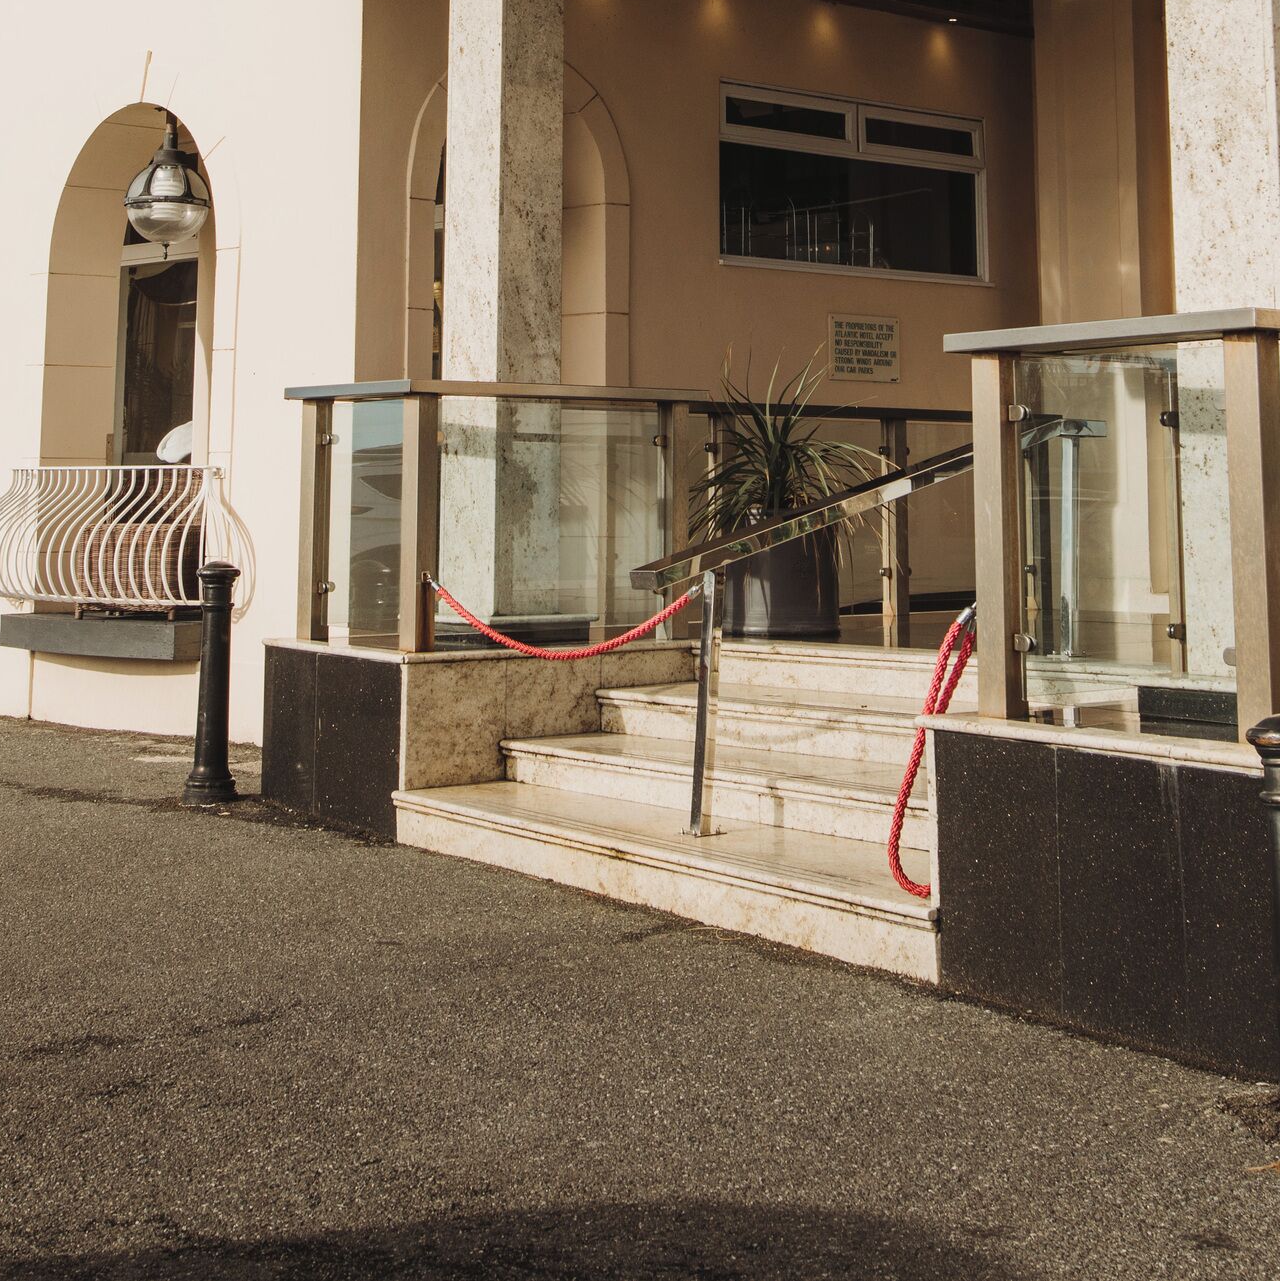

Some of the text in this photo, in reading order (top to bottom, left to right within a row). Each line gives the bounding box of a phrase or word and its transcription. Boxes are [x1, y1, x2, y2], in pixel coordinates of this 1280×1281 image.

[835, 330, 858, 339] ATLANTIC
[876, 333, 893, 341] ACCEPT
[844, 340, 882, 349] RESPONSIBILITY
[835, 348, 854, 356] CAUSED
[862, 350, 888, 358] VANDALISM
[835, 357, 854, 365] STRONG
[856, 358, 872, 366] WINDS
